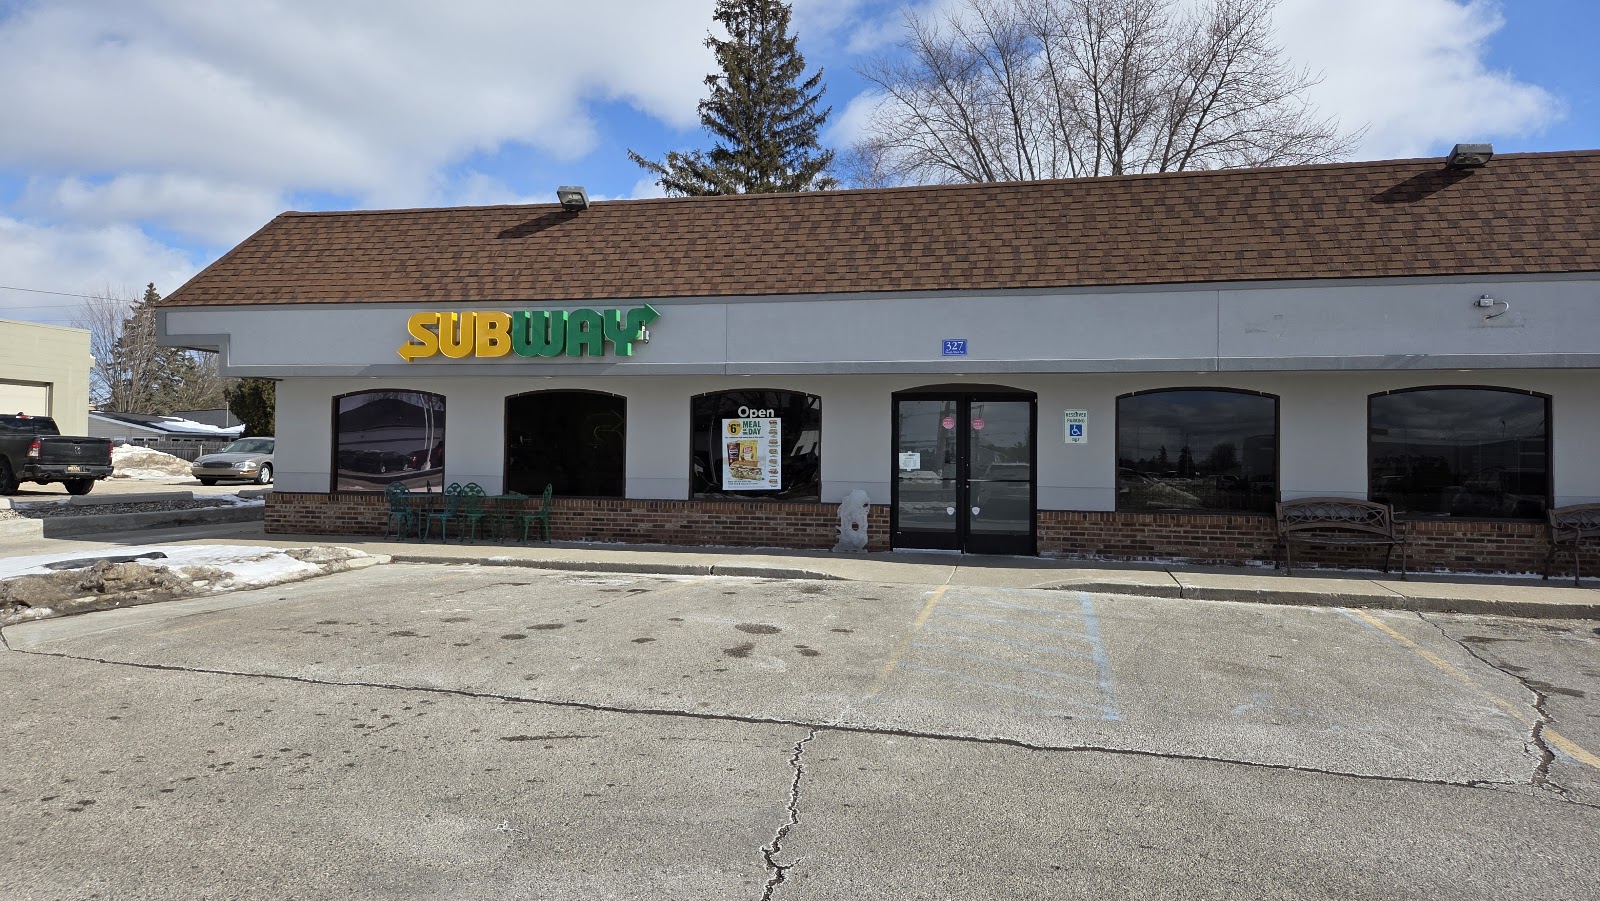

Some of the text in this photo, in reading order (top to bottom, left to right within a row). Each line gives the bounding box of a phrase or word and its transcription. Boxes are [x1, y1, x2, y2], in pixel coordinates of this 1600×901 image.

[397, 303, 661, 362] SUBWAY
[945, 341, 964, 352] 327
[737, 406, 775, 418] Open
